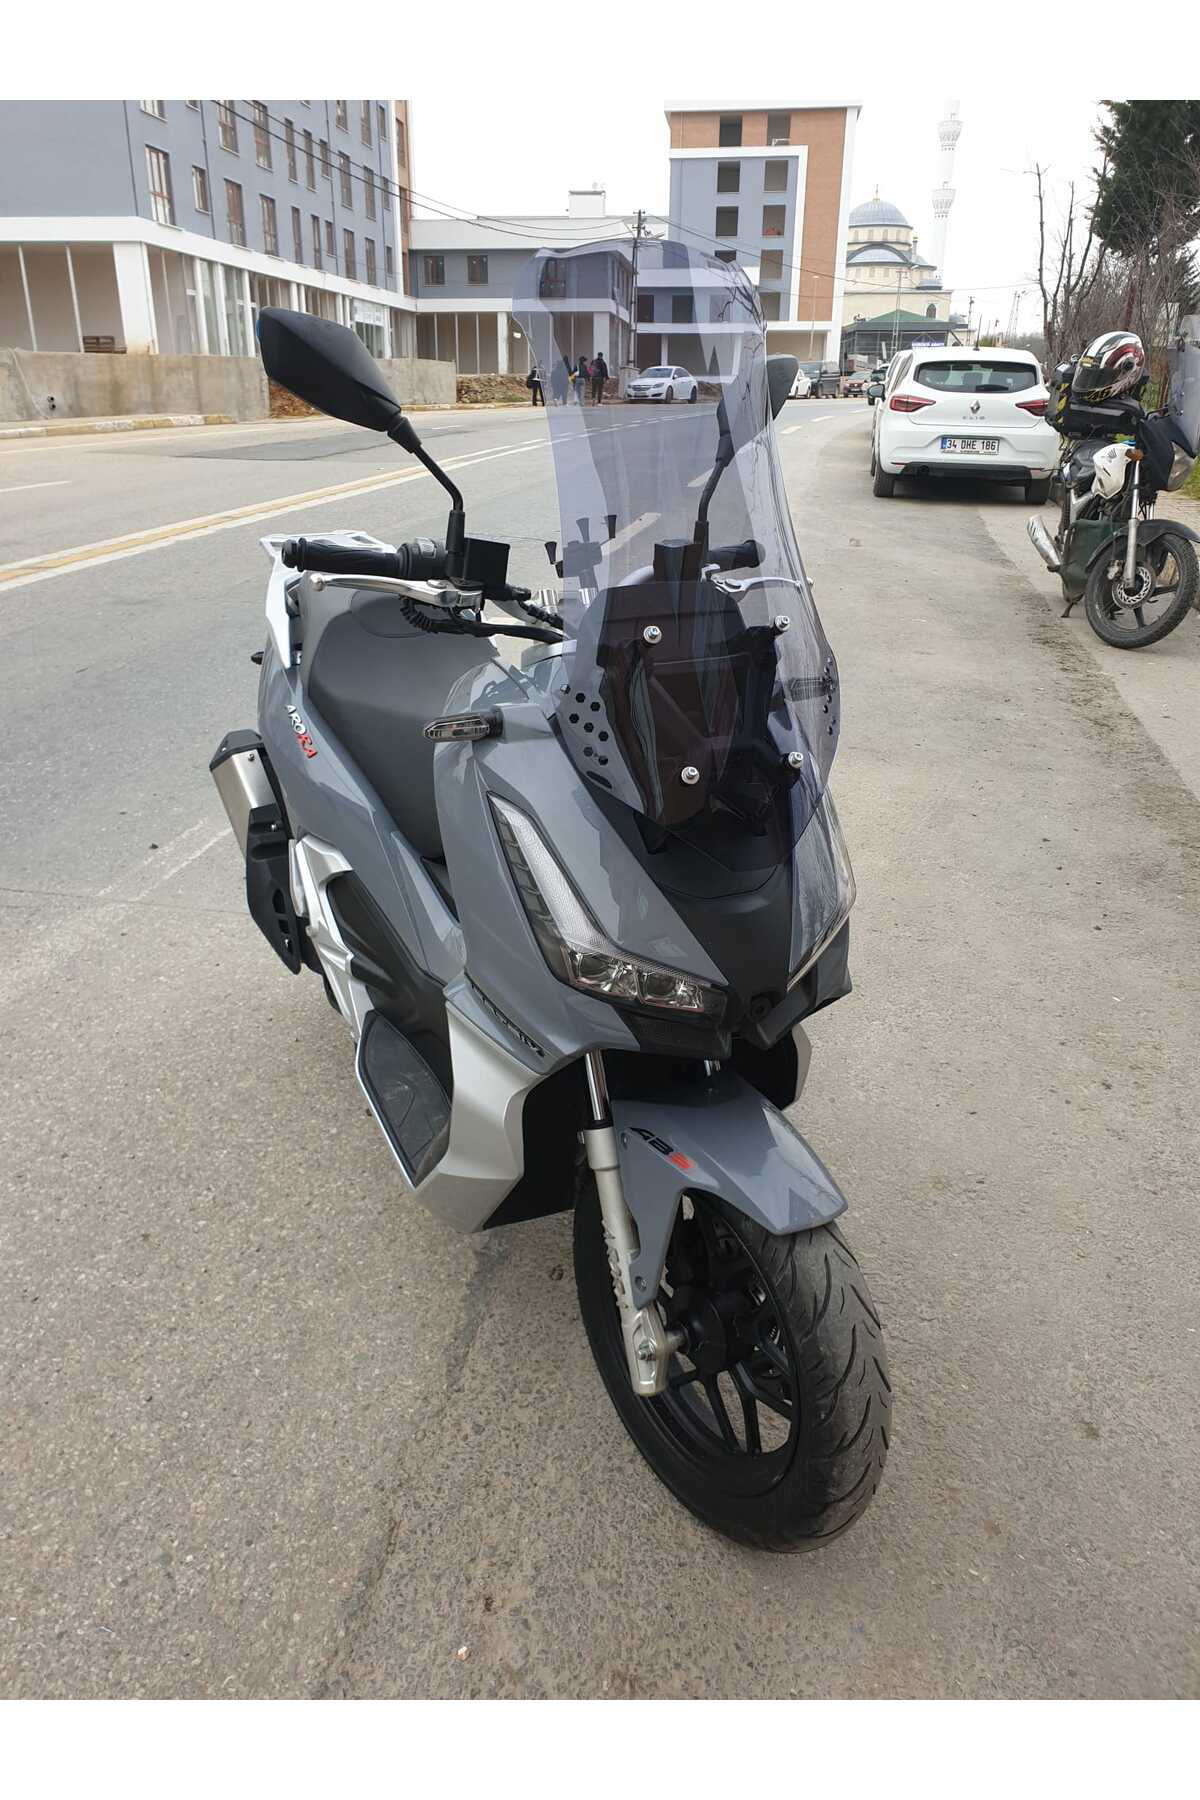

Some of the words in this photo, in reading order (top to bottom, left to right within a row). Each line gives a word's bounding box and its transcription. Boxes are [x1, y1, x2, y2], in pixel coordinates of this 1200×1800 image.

[947, 440, 957, 449] 34
[961, 440, 977, 450] DHE
[981, 441, 996, 450] 186
[285, 704, 318, 759] ARORA
[629, 1126, 695, 1172] ABS
